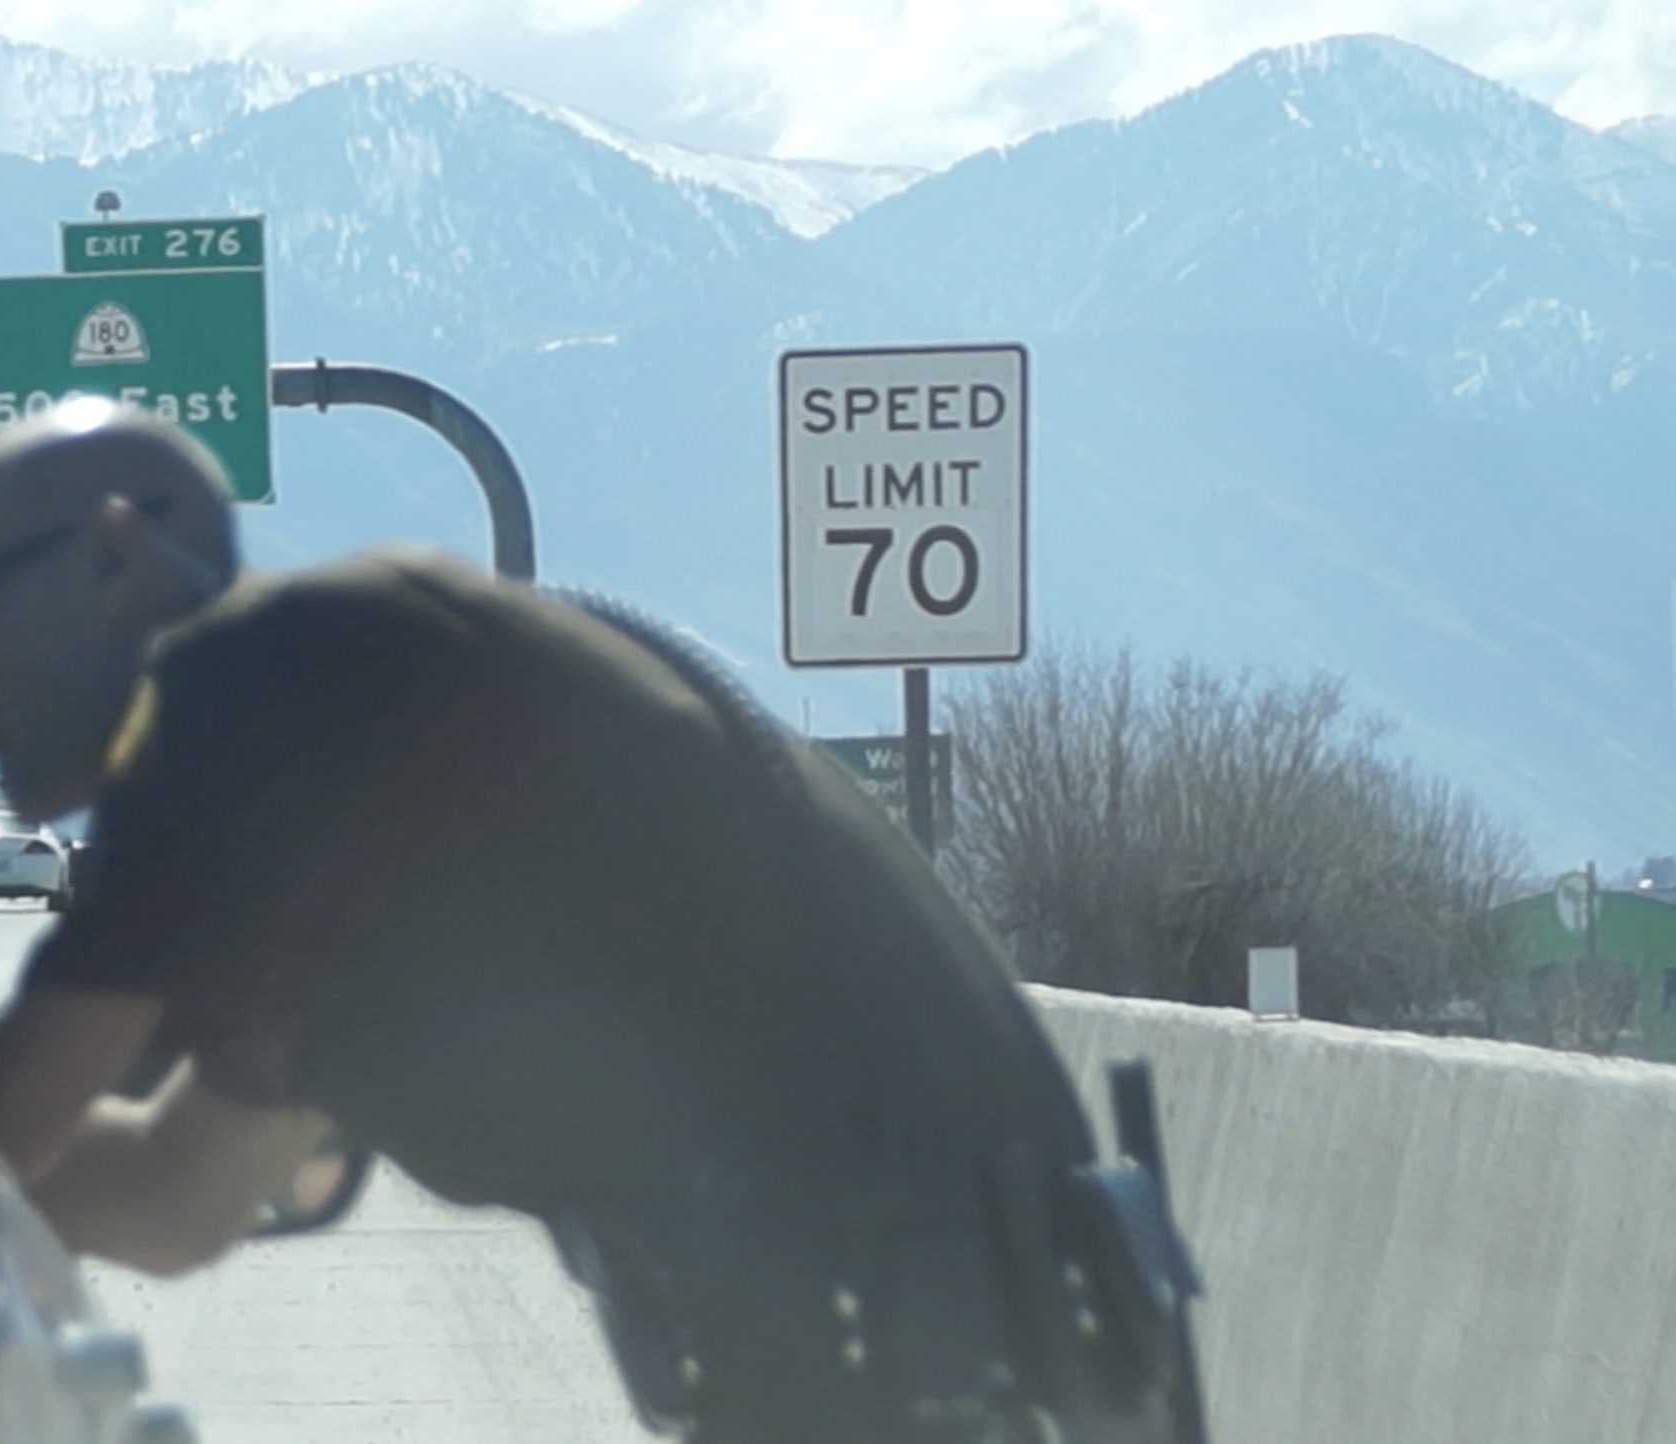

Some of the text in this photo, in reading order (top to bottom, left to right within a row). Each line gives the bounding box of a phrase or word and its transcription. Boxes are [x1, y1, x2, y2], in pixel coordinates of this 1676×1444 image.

[85, 228, 241, 258] EXIT 276
[89, 320, 130, 344] 180
[119, 384, 237, 422] East
[802, 384, 1006, 434] SPEED
[826, 460, 981, 509] LIMIT
[825, 525, 979, 617] 70
